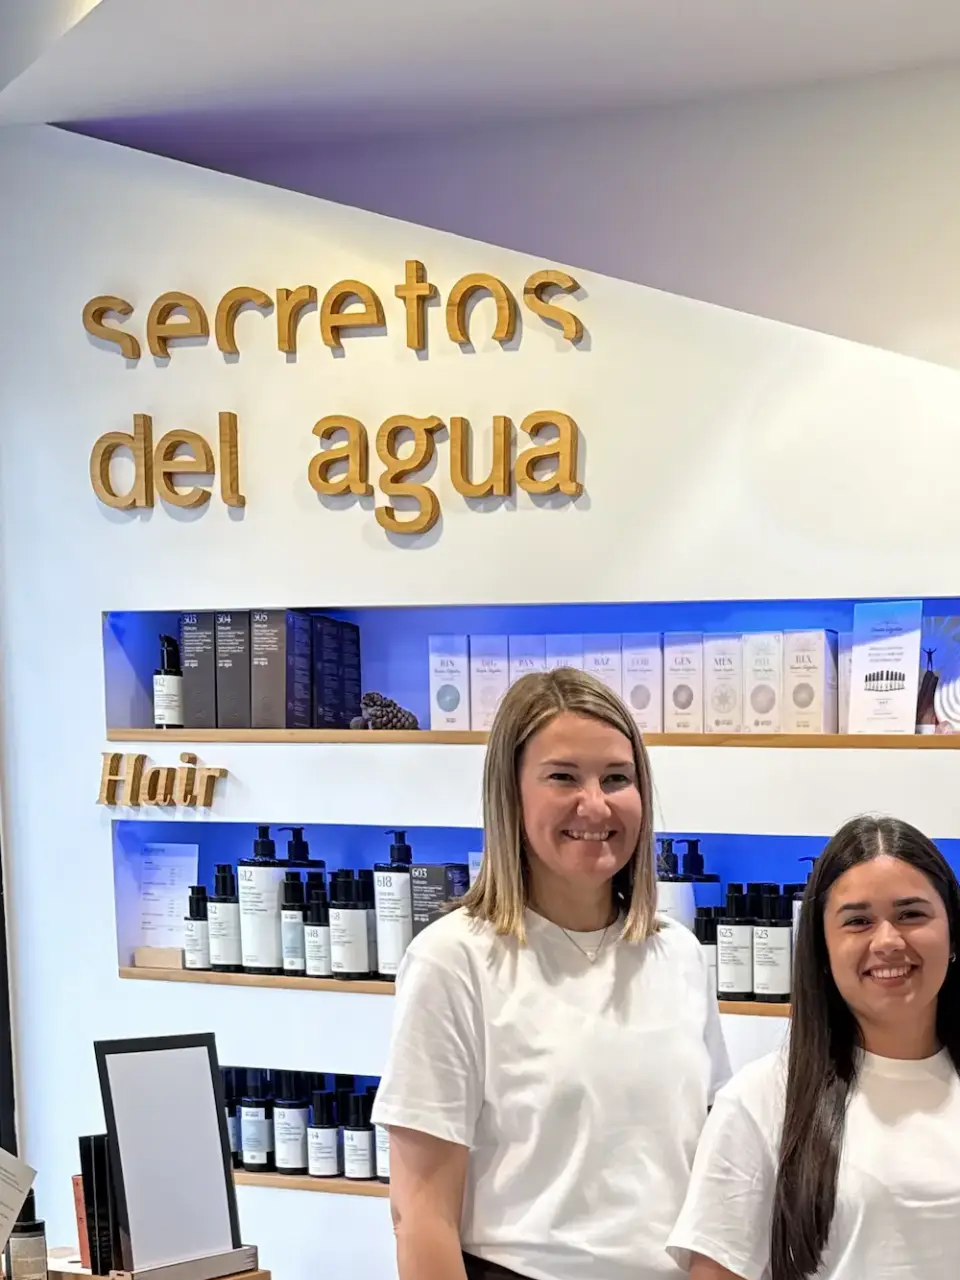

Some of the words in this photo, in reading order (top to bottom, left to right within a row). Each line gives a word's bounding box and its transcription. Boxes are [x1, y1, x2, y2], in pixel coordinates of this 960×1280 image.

[82, 260, 584, 360] secretos
[90, 411, 246, 511] del
[308, 410, 584, 535] agua
[94, 752, 228, 807] Hair
[412, 868, 427, 878] 603
